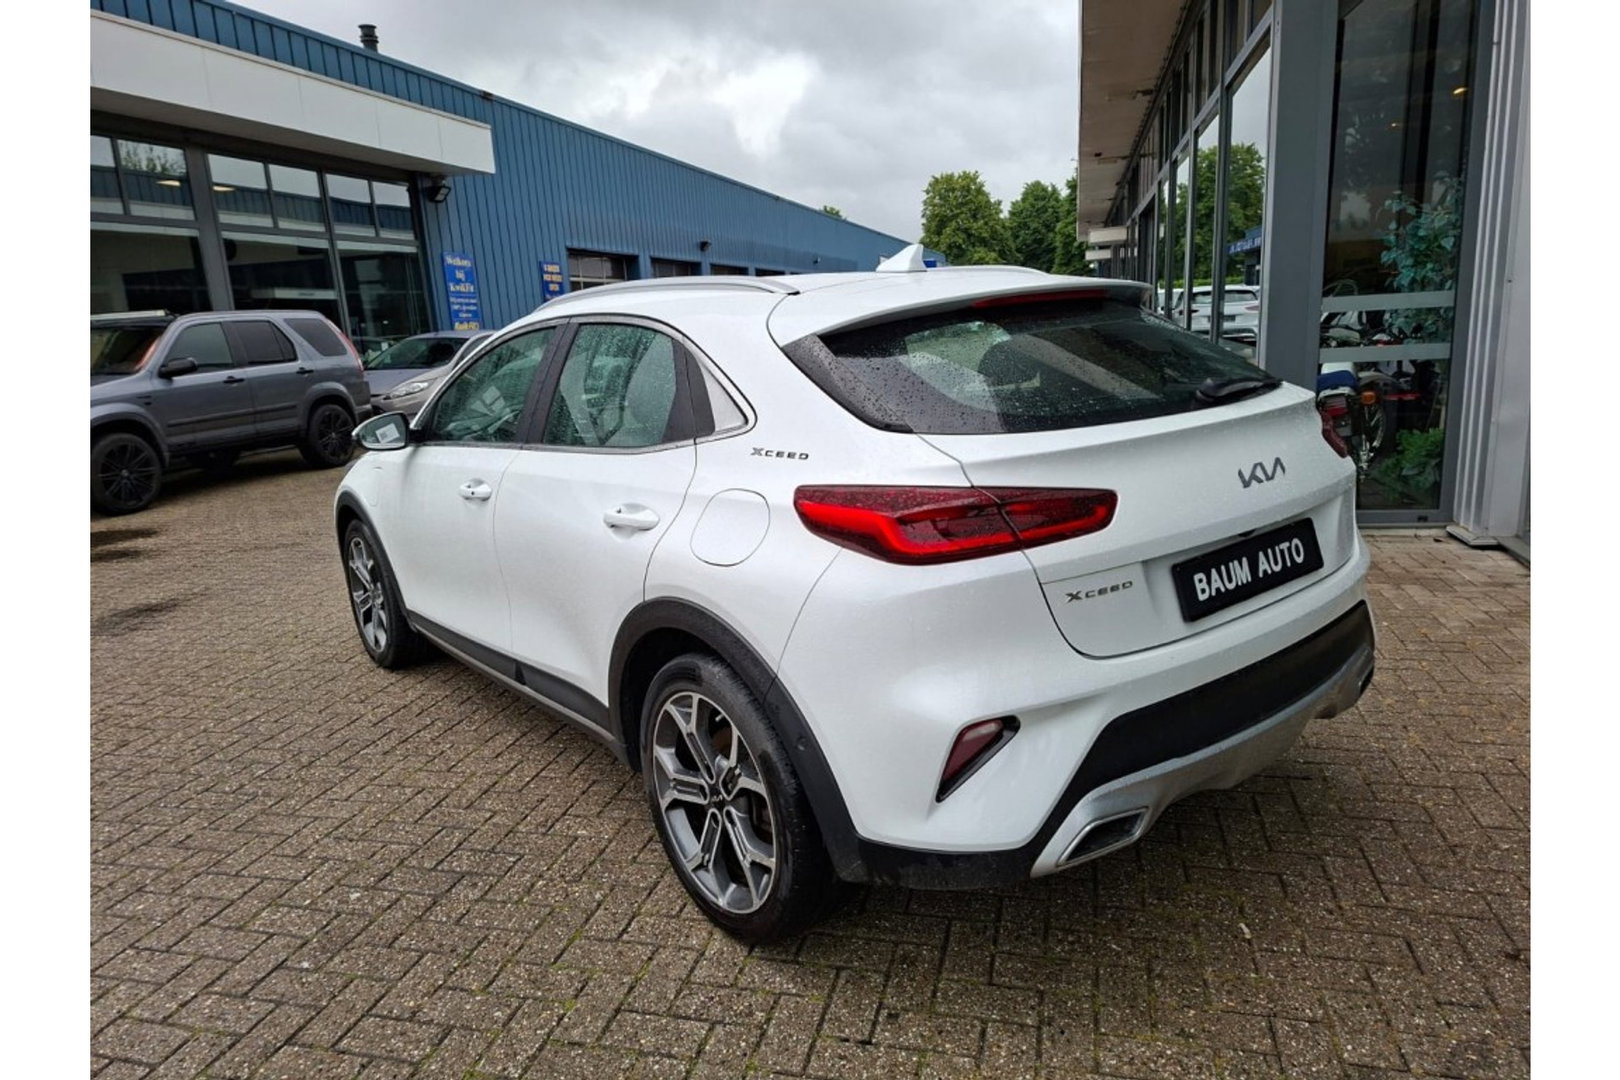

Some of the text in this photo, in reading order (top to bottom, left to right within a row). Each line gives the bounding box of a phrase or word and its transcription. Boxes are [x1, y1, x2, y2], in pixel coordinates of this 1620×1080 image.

[750, 447, 809, 460] XCEED
[1238, 457, 1286, 489] KIA
[1193, 537, 1305, 601] BAUM AUTO
[1065, 580, 1134, 604] XCEED
